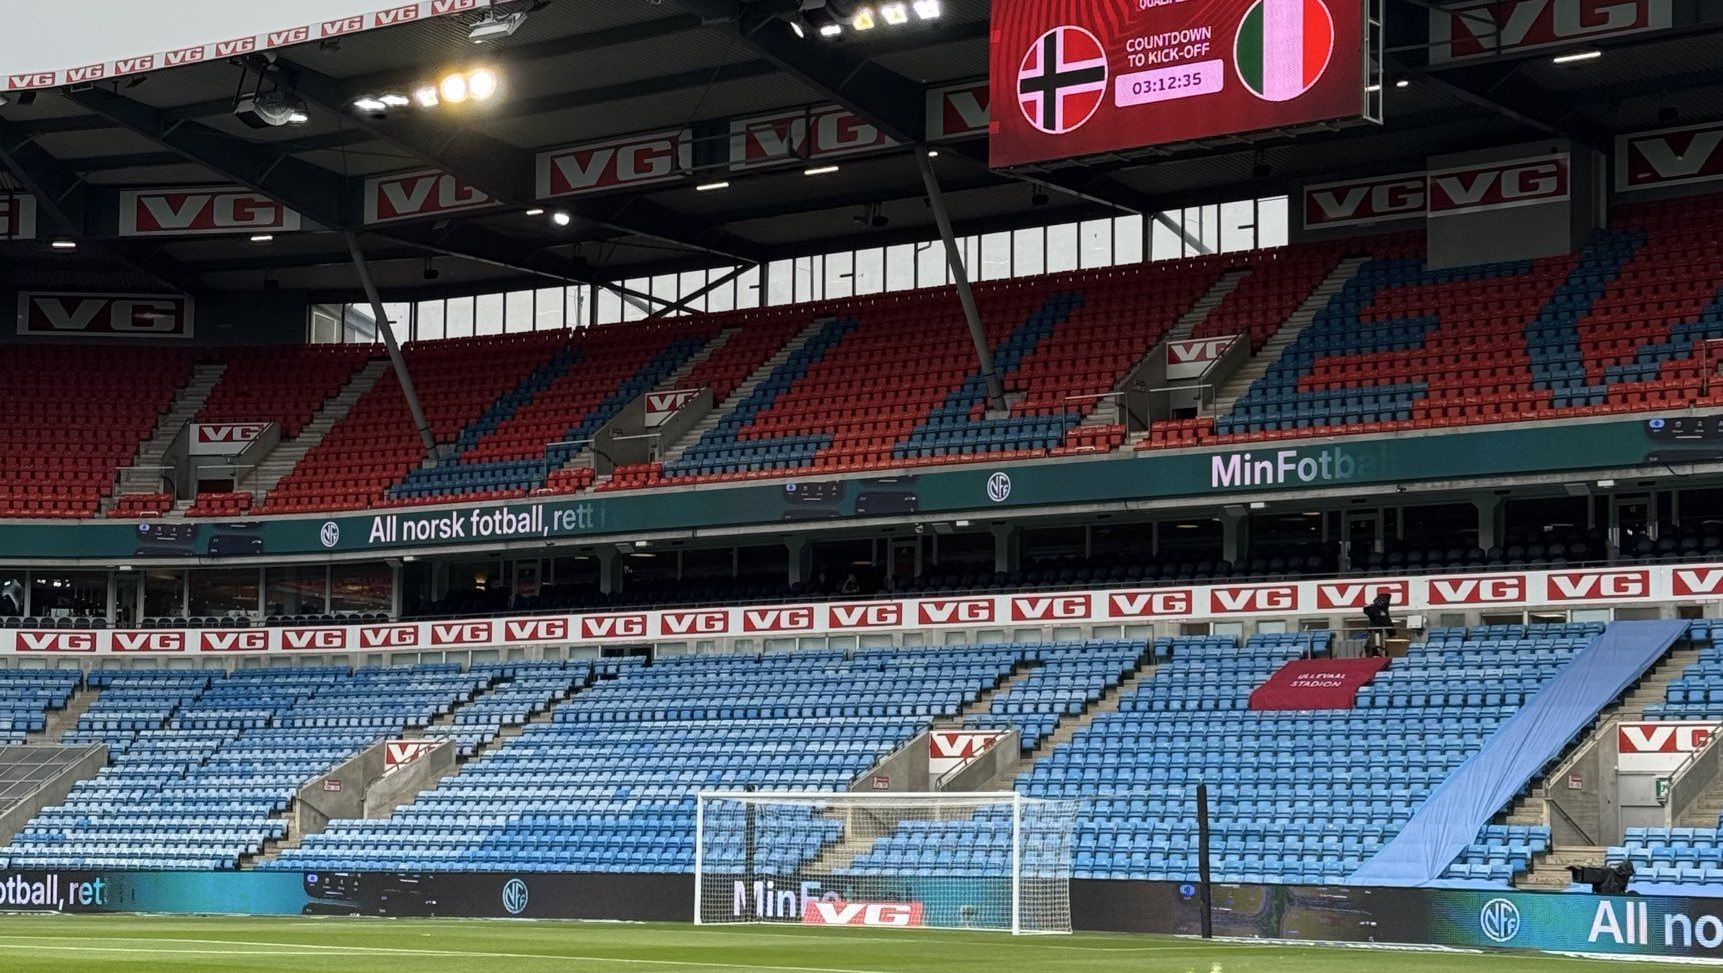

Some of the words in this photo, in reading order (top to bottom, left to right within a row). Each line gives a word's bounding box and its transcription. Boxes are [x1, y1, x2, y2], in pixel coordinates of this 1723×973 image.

[376, 6, 417, 24] VG
[1457, 0, 1637, 49] VG
[269, 28, 307, 45] VG
[322, 17, 362, 35] VG
[216, 38, 254, 55] VG
[1126, 26, 1212, 52] COUNTDOWN
[116, 57, 152, 73] VG
[166, 48, 203, 64] VG
[1127, 53, 1145, 67] TO
[1148, 42, 1210, 65] KICK-OFF
[11, 74, 53, 88] VG
[67, 65, 102, 82] VG
[1132, 72, 1202, 95] 03:12:35
[751, 113, 878, 156] VG
[554, 141, 672, 189] VG
[1436, 163, 1558, 205] VG
[1311, 180, 1424, 219] VG
[140, 194, 276, 229] VG
[33, 299, 176, 331] VG
[201, 426, 262, 441] VG
[369, 515, 396, 543] All
[403, 511, 465, 541] norsk
[470, 505, 549, 537] fotball,
[553, 503, 593, 531] rett
[1320, 584, 1403, 606] VG
[1433, 578, 1519, 601] VG
[1551, 573, 1643, 598] VG
[1015, 597, 1086, 618] VG
[1112, 592, 1187, 615] VG
[1214, 588, 1292, 611] VG
[746, 609, 810, 630] VG
[832, 605, 898, 626] VG
[921, 601, 990, 622] VG
[433, 623, 488, 643] VG
[507, 620, 564, 640] VG
[585, 616, 644, 637] VG
[663, 613, 725, 633] VG
[19, 633, 92, 650] VG
[114, 633, 182, 650] VG
[204, 632, 266, 650] VG
[284, 630, 343, 648] VG
[362, 627, 415, 646] VG
[815, 903, 910, 926] VG
[1588, 900, 1648, 945] All
[1664, 913, 1723, 948] no
